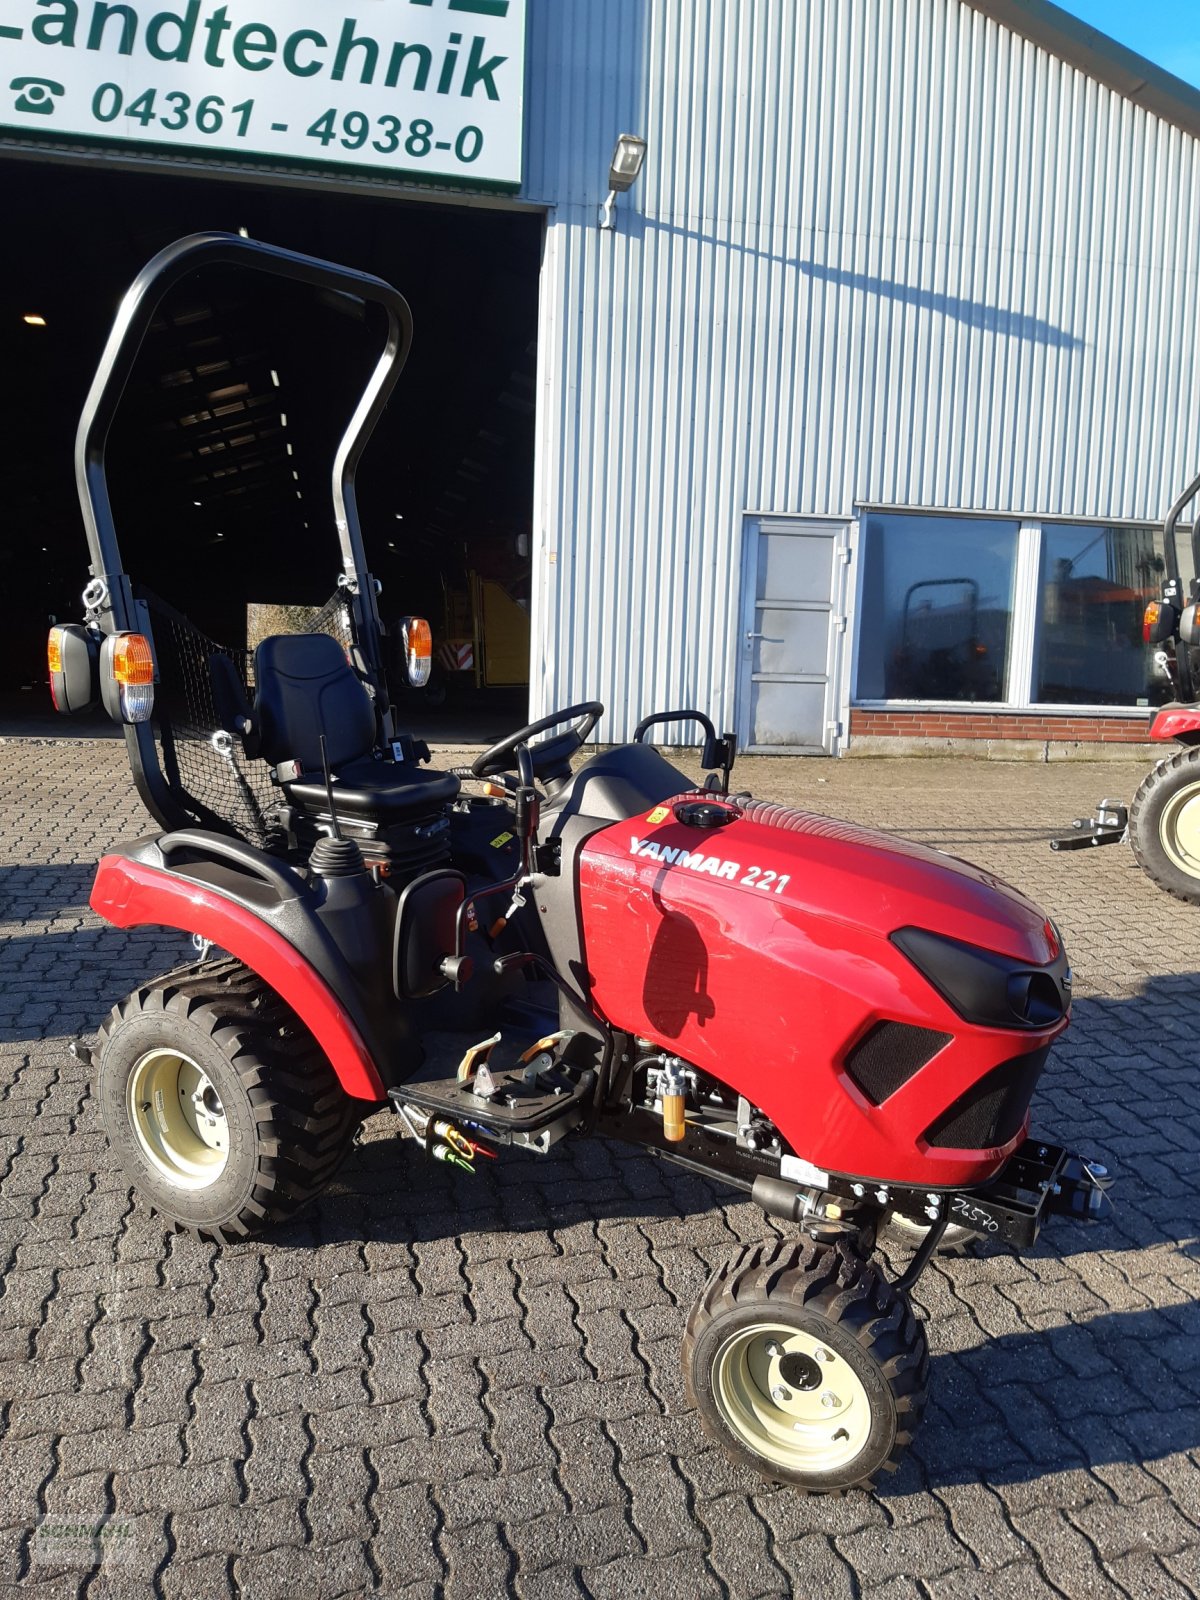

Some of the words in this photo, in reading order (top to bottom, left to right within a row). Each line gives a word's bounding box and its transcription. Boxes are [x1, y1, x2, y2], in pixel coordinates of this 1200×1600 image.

[91, 82, 254, 137] 04361
[306, 107, 484, 163] 4938-0
[629, 836, 740, 880] YANMAR
[740, 866, 791, 894] 221
